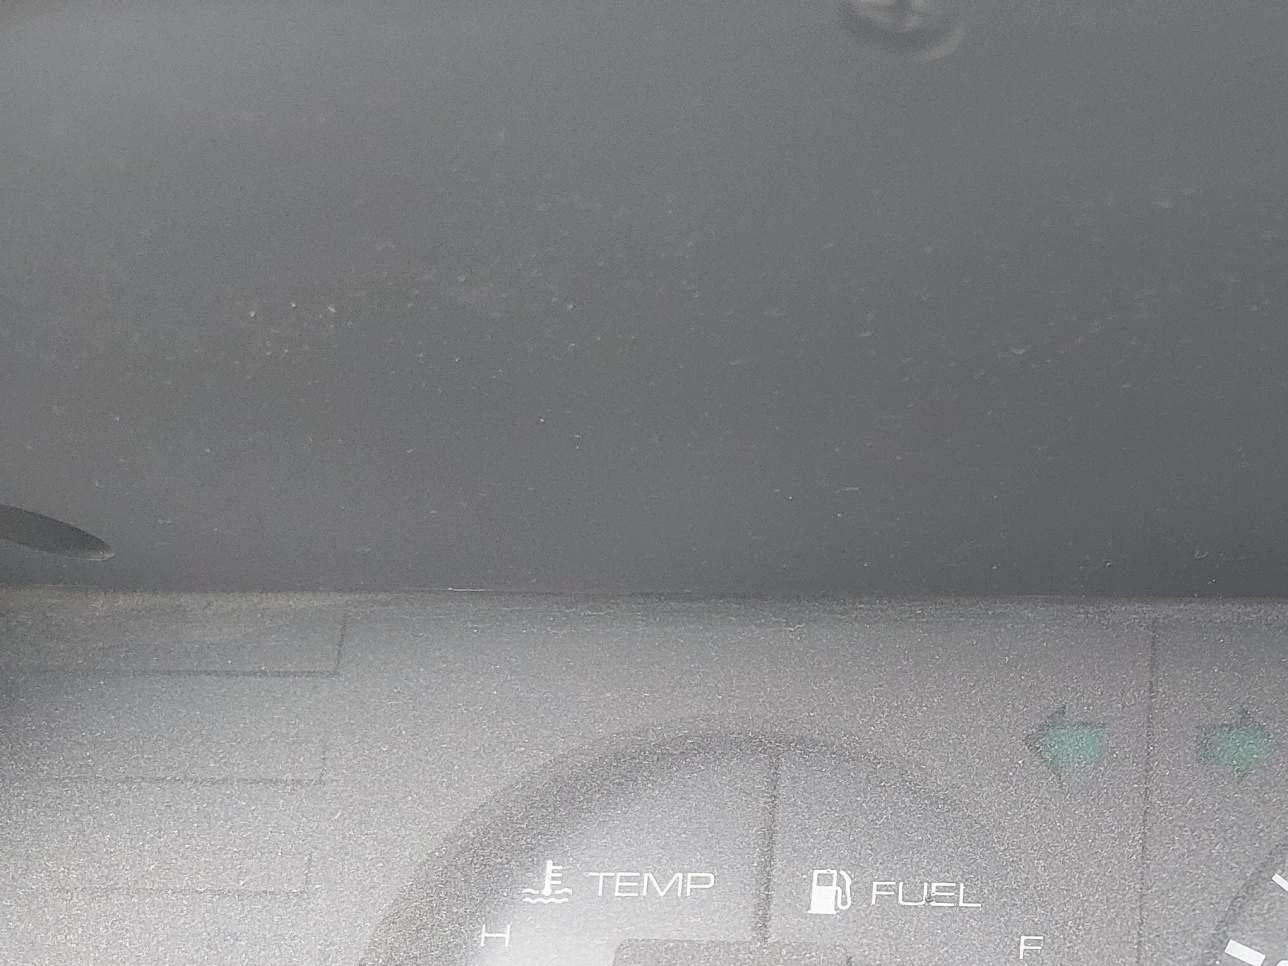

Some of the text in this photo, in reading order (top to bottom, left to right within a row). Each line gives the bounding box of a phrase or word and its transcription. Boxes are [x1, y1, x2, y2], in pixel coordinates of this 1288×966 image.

[589, 872, 716, 898] TEMP
[871, 881, 982, 908] FUEL
[480, 925, 511, 948] H
[1020, 936, 1044, 960] F
